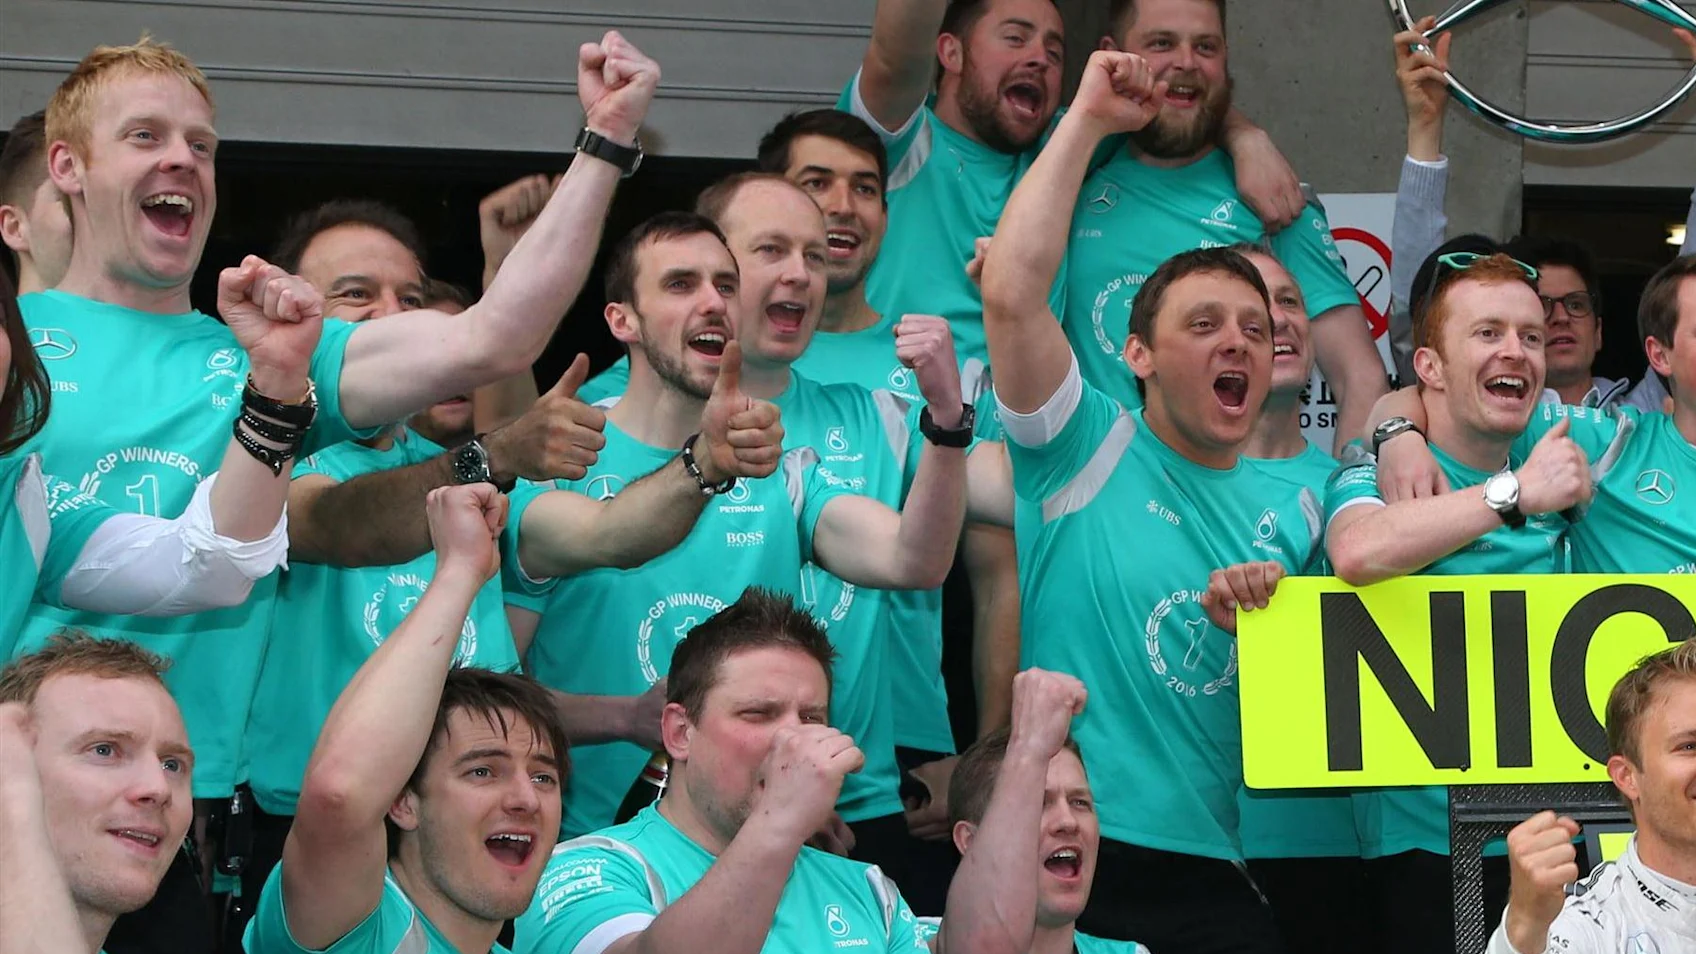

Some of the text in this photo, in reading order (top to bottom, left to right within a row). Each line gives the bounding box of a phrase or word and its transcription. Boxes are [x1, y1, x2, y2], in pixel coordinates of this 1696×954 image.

[97, 447, 200, 477] GP WINNERS
[719, 505, 764, 514] PETRONAS
[1159, 507, 1181, 525] UBS
[726, 530, 764, 544] BOSS
[1171, 592, 1189, 605] GP
[649, 600, 667, 619] GP
[1166, 677, 1196, 698] 2016
[540, 865, 600, 897] EPSON
[833, 938, 869, 948] TRONAS
